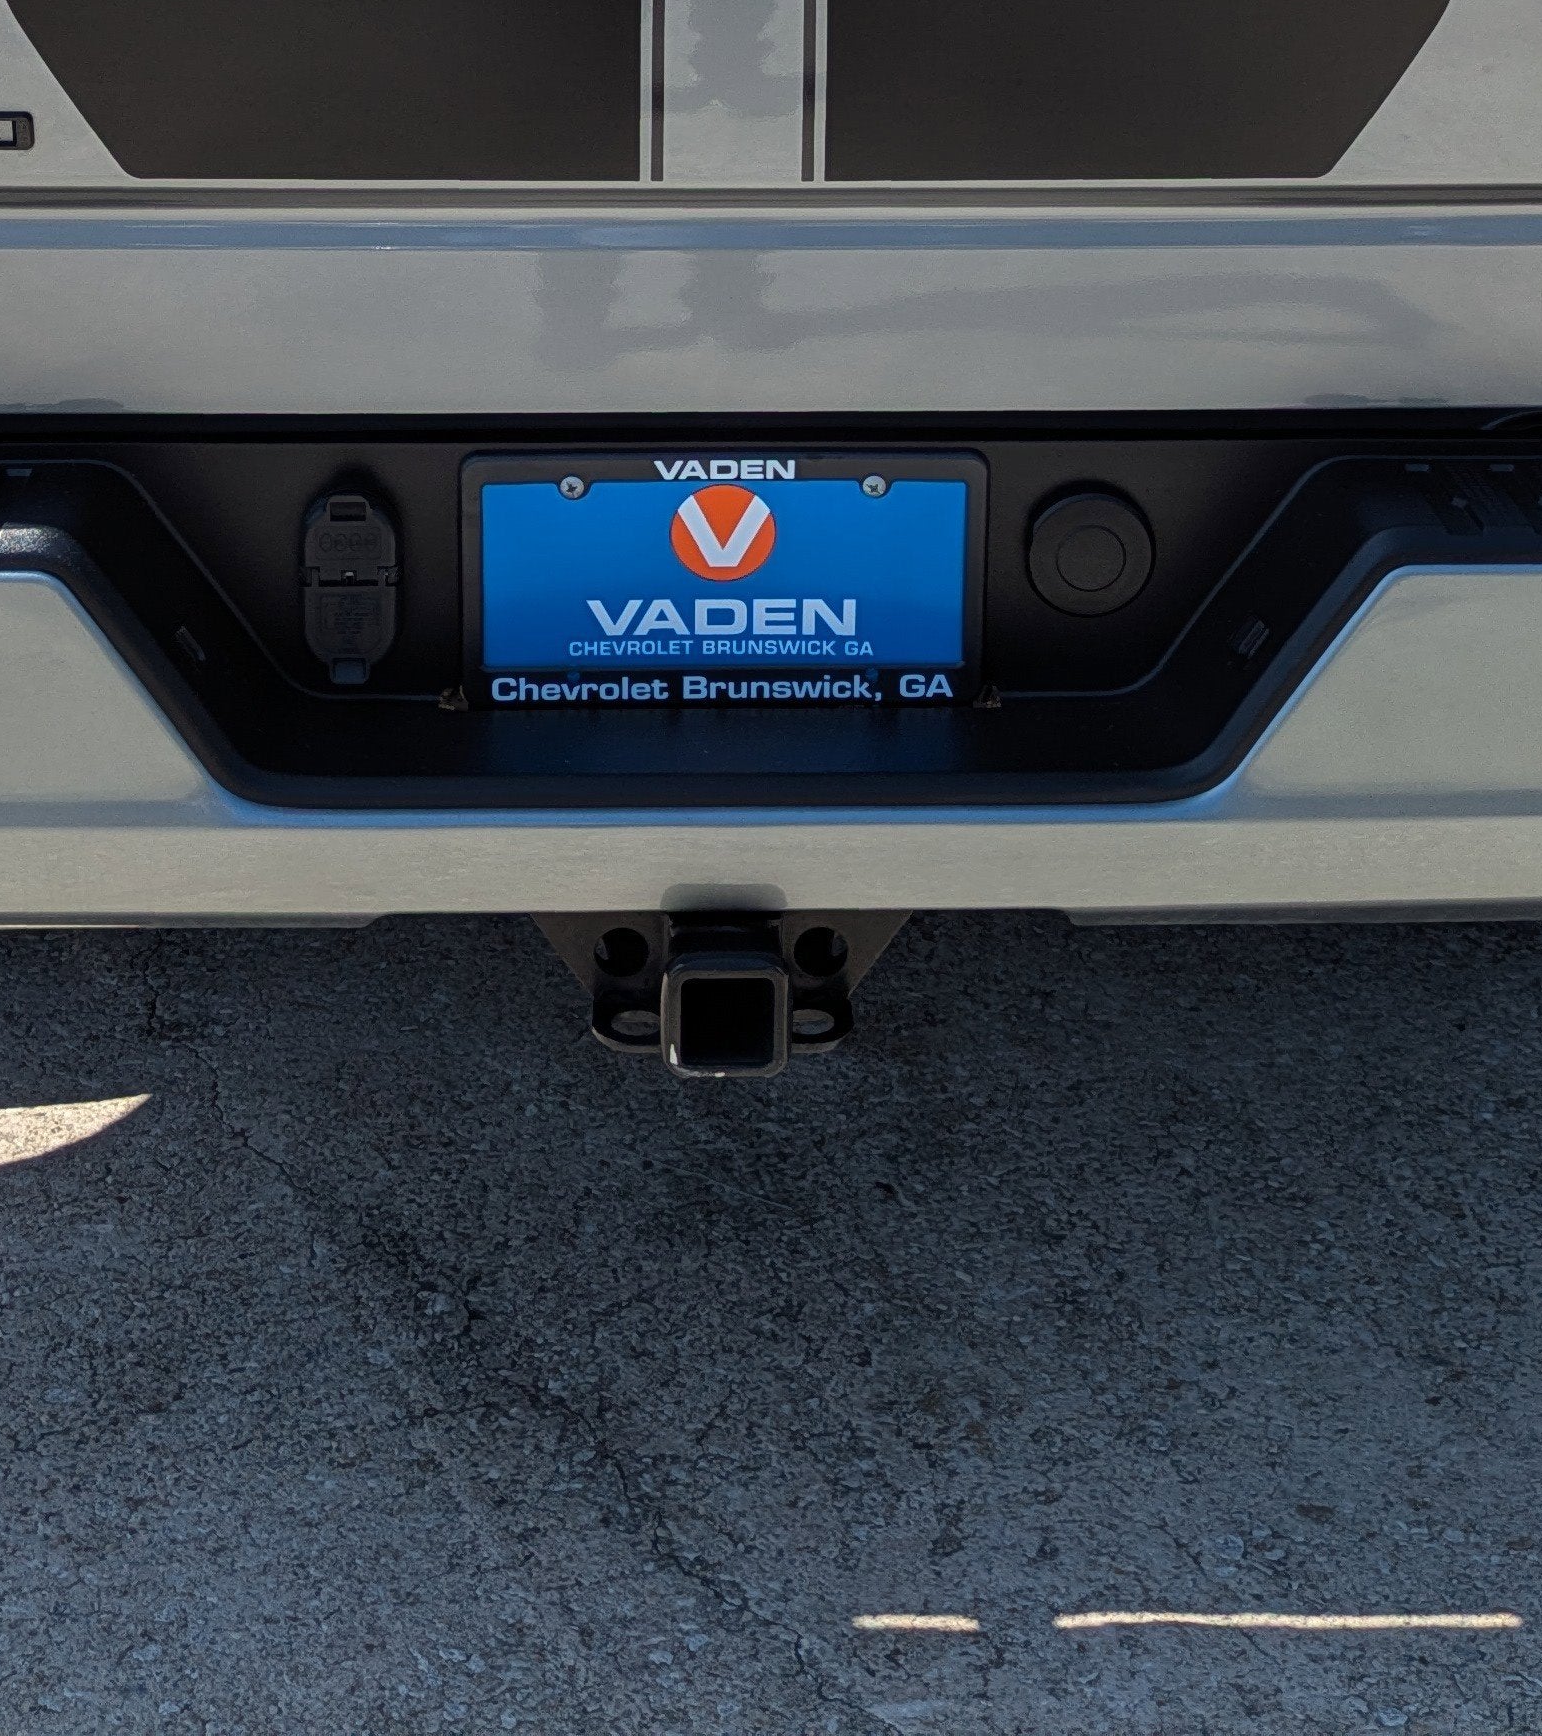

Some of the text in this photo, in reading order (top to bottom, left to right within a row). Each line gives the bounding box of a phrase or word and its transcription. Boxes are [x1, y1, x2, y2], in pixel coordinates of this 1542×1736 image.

[653, 459, 796, 480] VADEN
[676, 494, 772, 568] V
[586, 599, 857, 636] VADEN
[569, 639, 874, 657] CHEVROLET BRUNSWICK GA
[491, 673, 954, 702] Chevrolet Brunswick, GA
